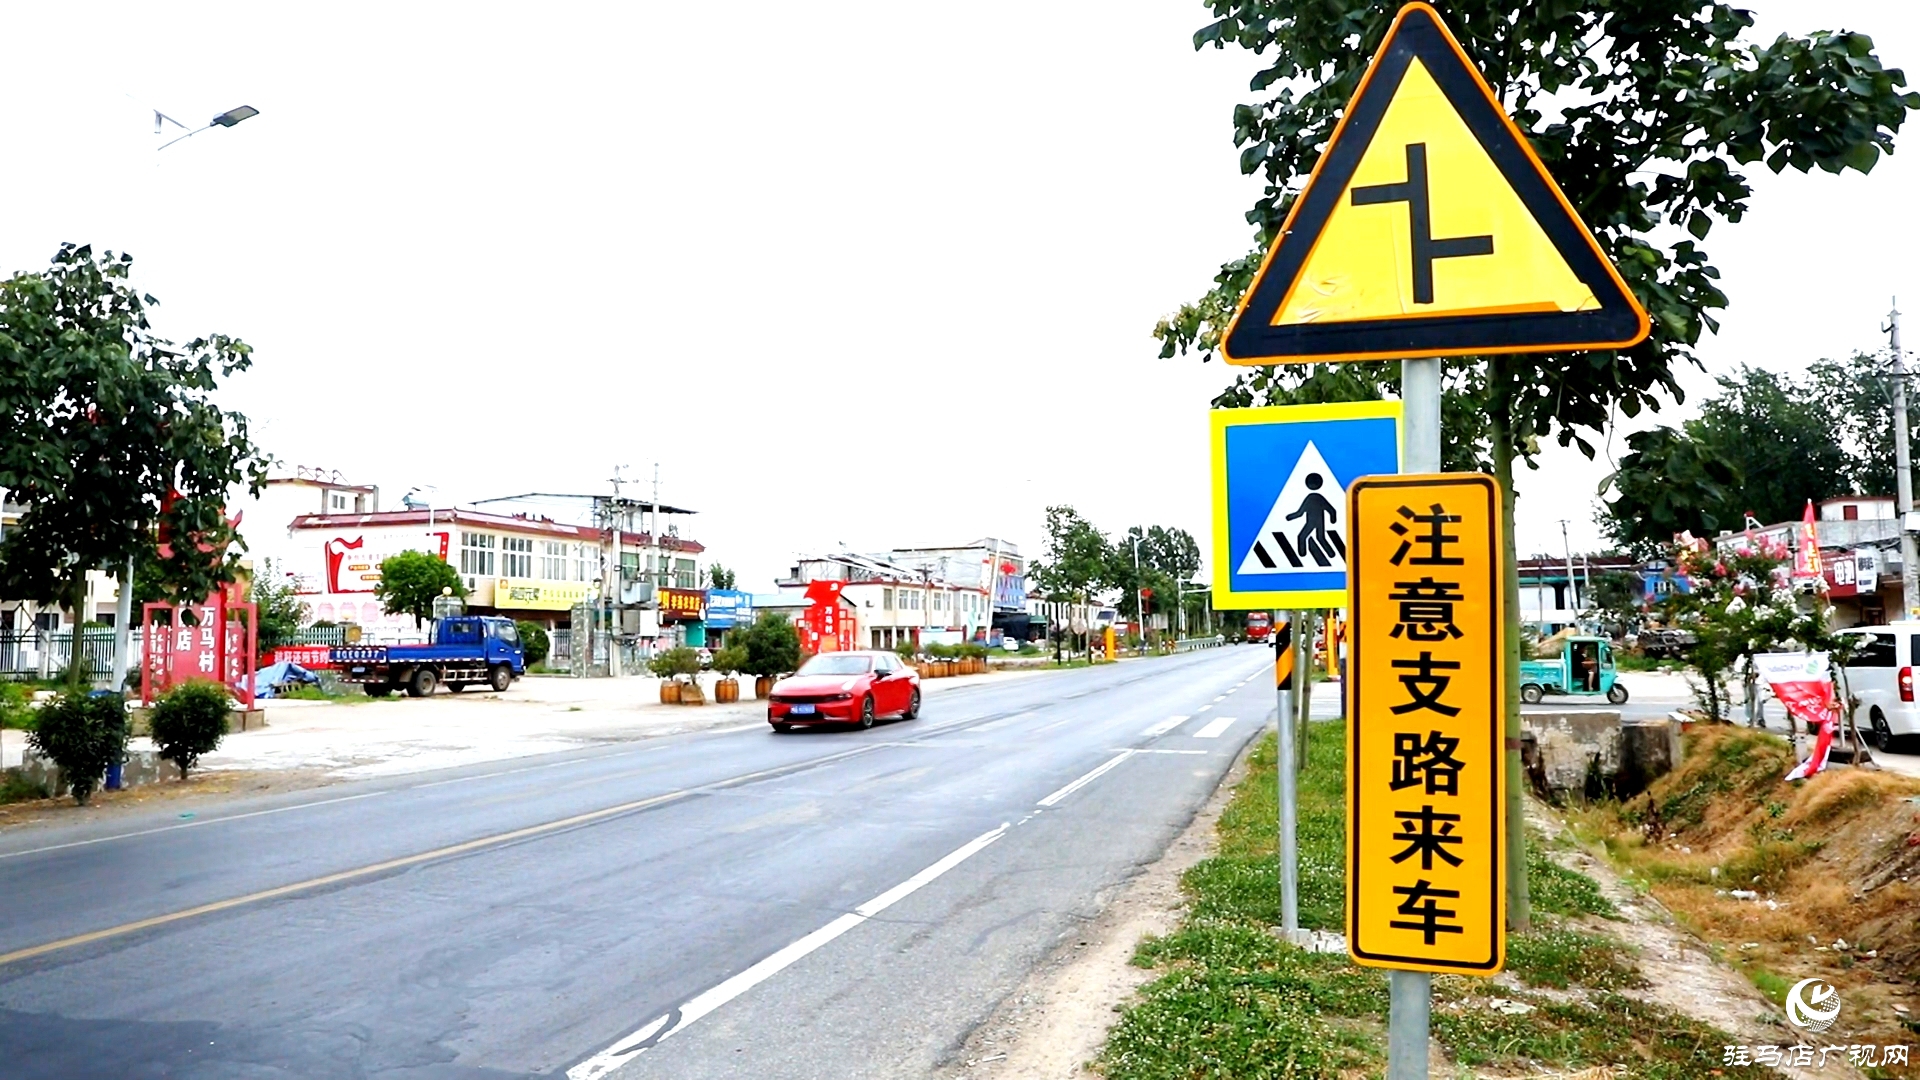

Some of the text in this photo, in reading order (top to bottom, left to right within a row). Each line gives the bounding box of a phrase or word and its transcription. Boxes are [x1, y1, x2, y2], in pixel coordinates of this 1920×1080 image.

[198, 606, 216, 673] 万马村
[1389, 502, 1466, 945] 注意支路来车
